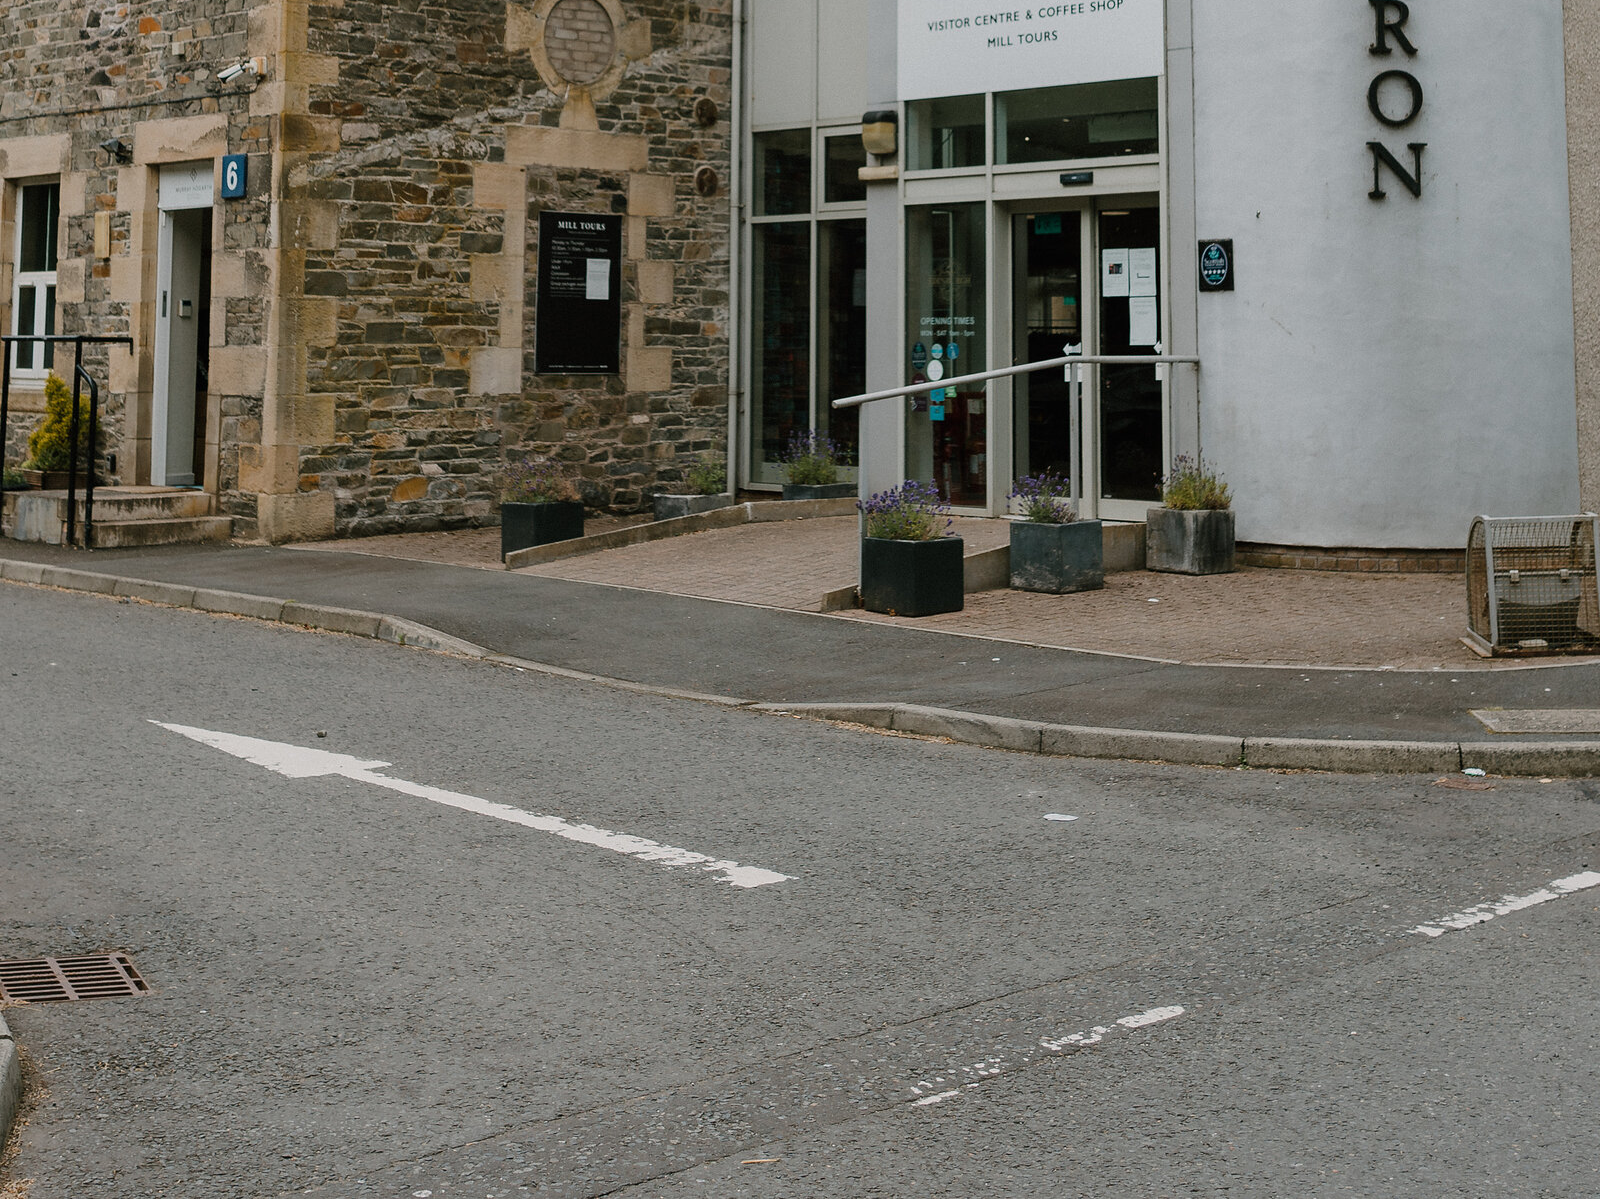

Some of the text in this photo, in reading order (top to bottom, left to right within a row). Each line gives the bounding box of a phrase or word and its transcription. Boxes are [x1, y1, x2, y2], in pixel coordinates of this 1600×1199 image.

[927, 17, 970, 31] VISITOR
[975, 10, 1020, 26] CENTRE
[1025, 9, 1033, 20] &
[1038, 3, 1085, 18] COFFEE
[987, 30, 1058, 48] MILL TOURS
[226, 161, 238, 191] 6
[558, 221, 606, 230] MILL TOURS
[920, 317, 975, 325] OPENING TIMES
